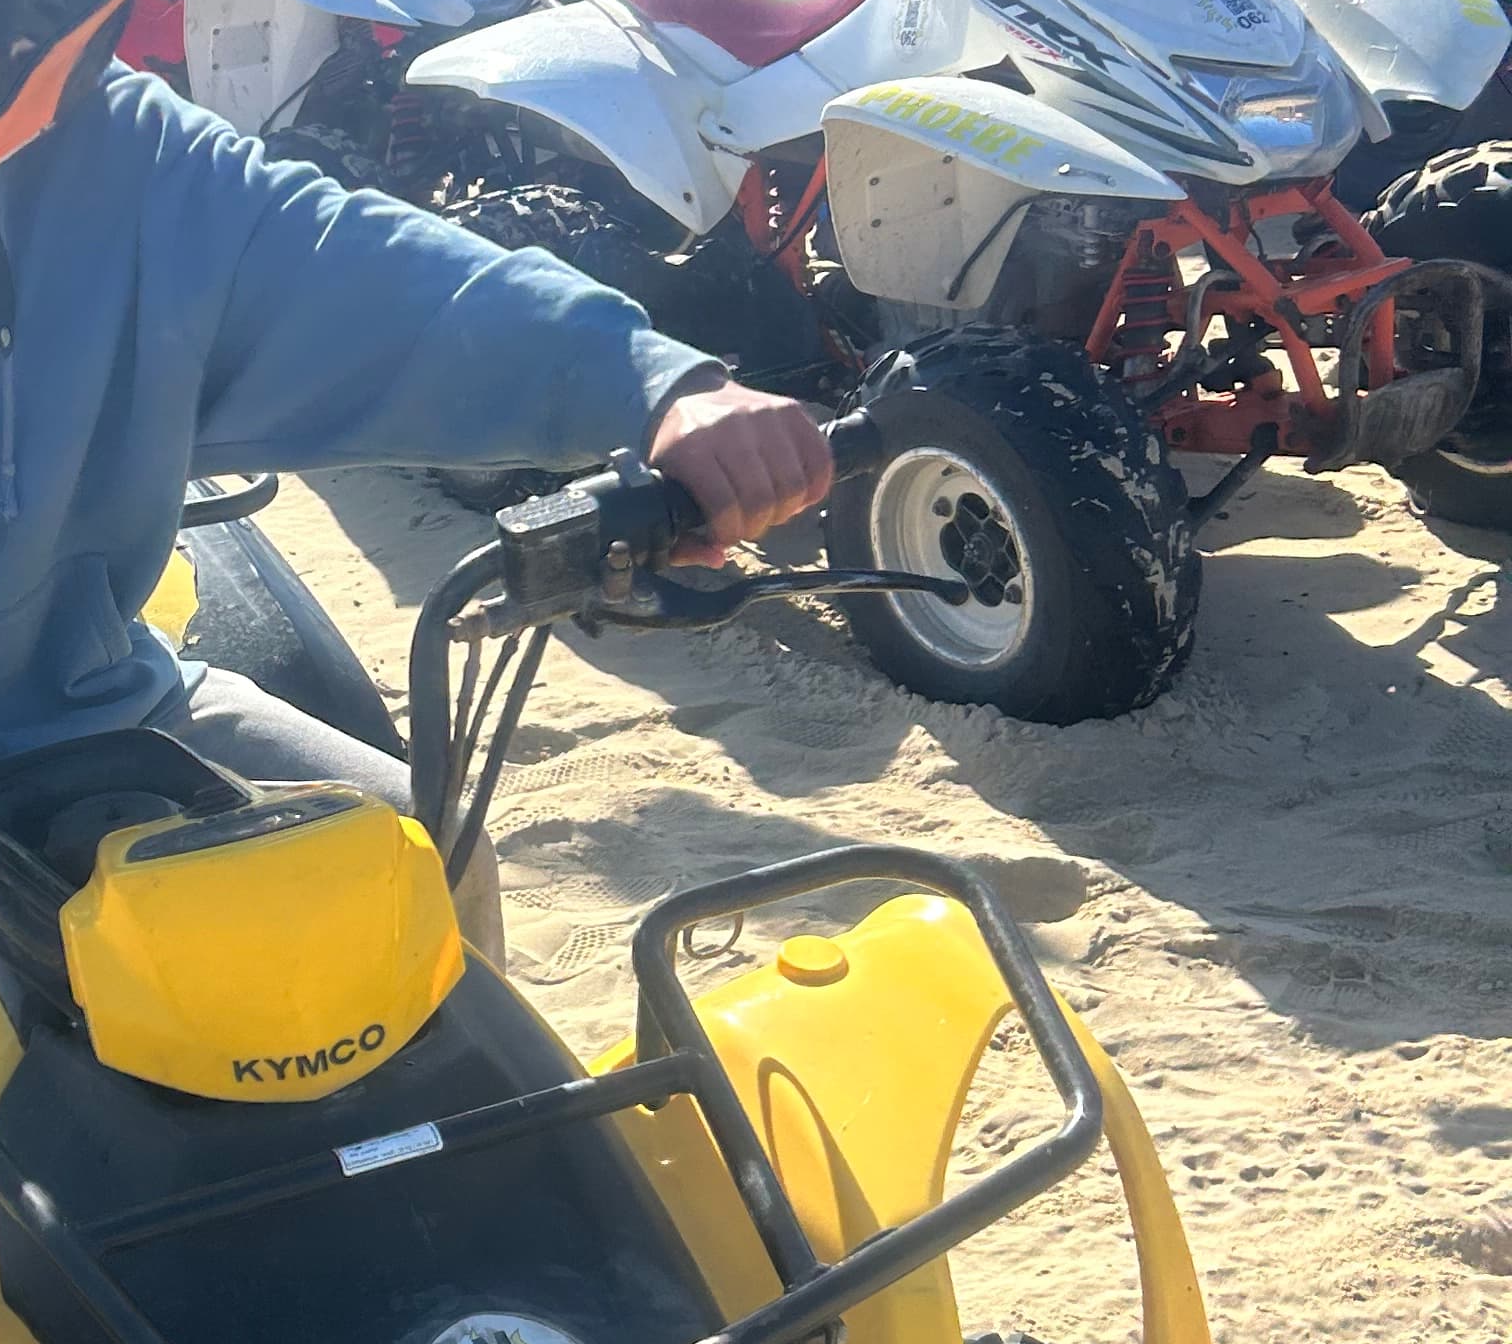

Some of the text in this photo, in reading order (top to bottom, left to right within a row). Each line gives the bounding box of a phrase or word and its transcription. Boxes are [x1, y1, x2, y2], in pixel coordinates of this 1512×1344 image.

[1237, 10, 1270, 29] 062
[858, 85, 1046, 164] PHOEBE
[232, 1023, 386, 1083] KYMCO
